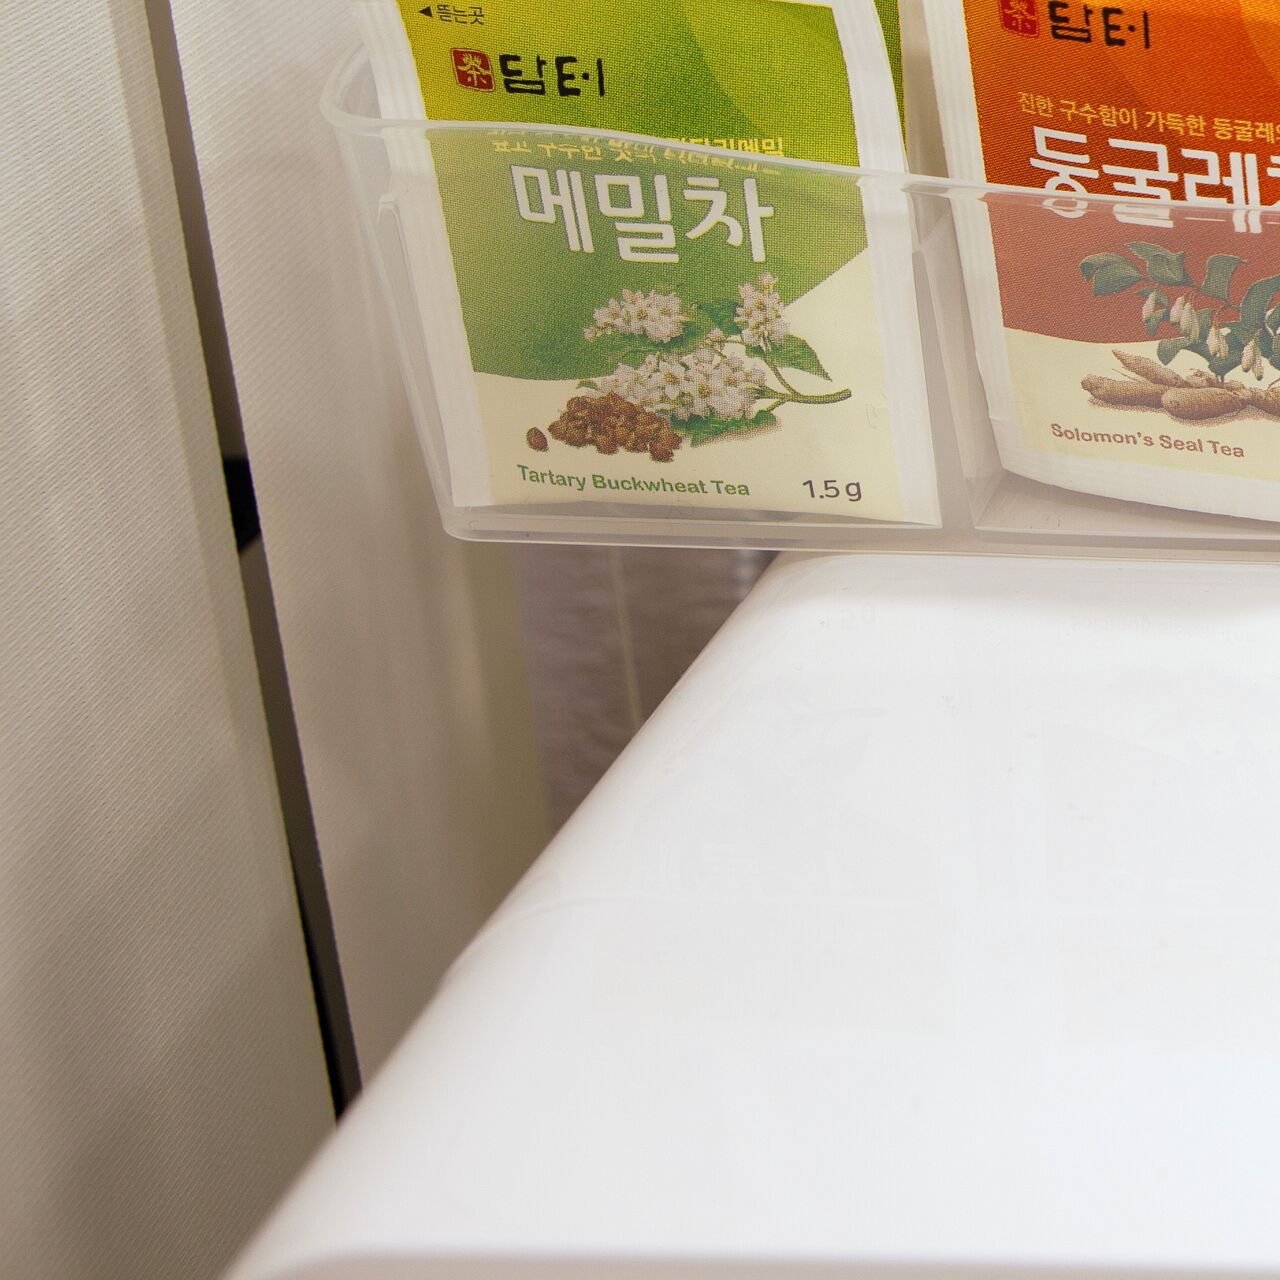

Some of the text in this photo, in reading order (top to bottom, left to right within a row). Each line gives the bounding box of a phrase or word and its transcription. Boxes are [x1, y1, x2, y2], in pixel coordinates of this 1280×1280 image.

[437, 4, 485, 25] 뜯는곳
[1047, 0, 1151, 49] 담터
[499, 54, 605, 97] 담터
[1018, 91, 1053, 118] 진한
[1060, 100, 1138, 131] 구수함이
[1146, 111, 1206, 138] 가득한
[510, 165, 774, 263] 메밀차
[1159, 434, 1203, 453] Seal
[1208, 439, 1245, 458] Tea
[517, 464, 750, 496] Tartary Buckwheat Tea
